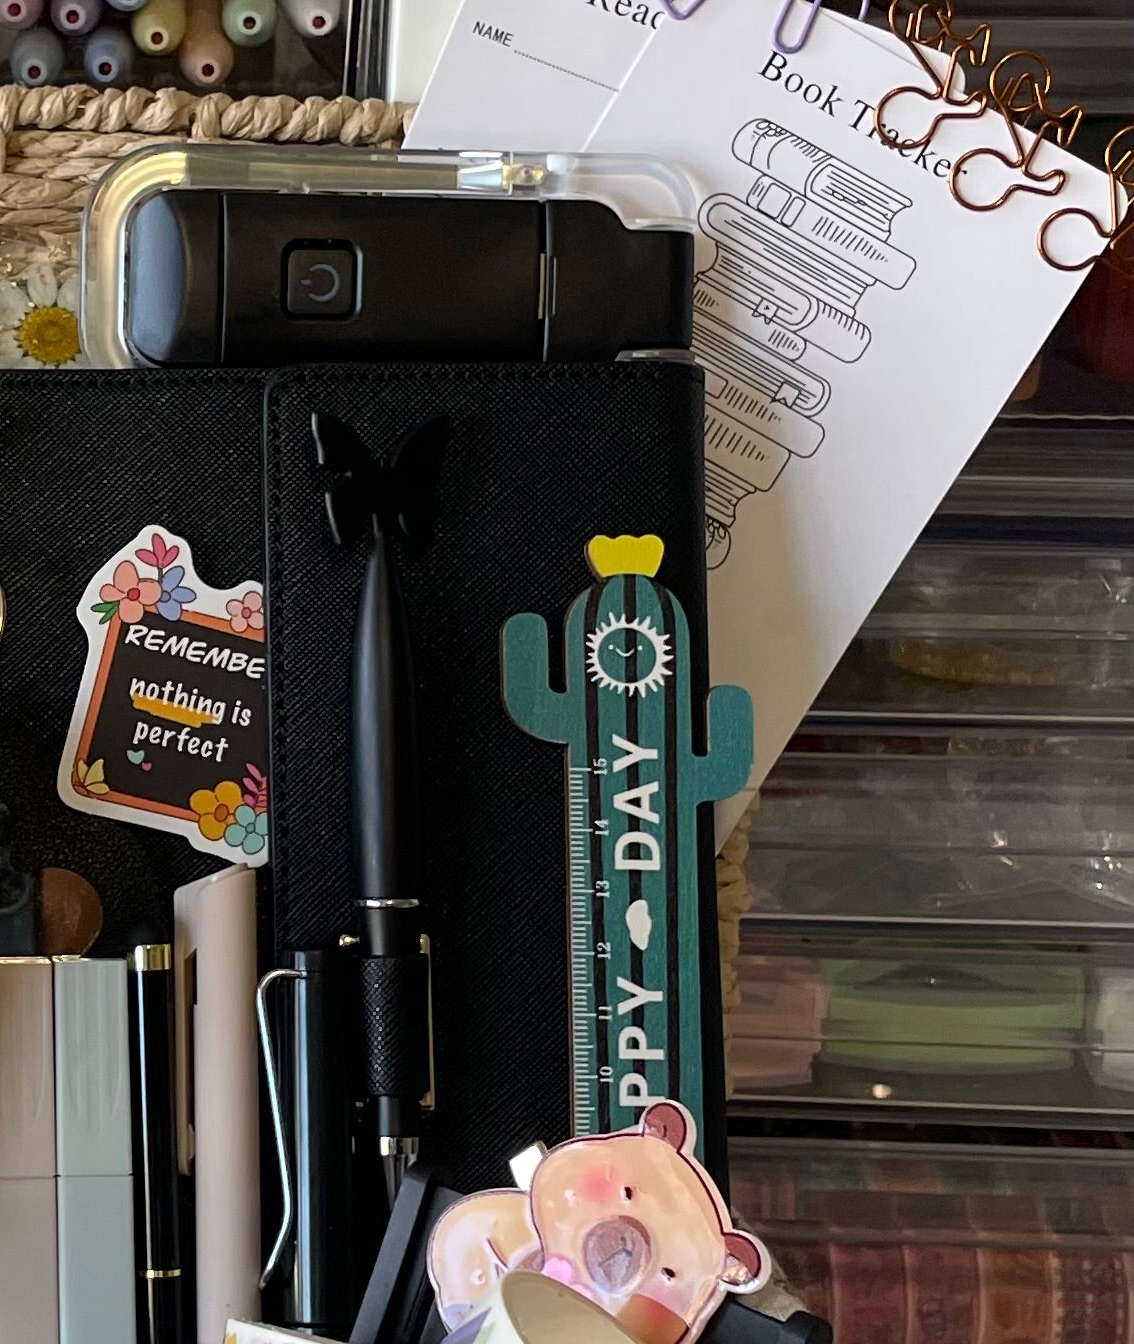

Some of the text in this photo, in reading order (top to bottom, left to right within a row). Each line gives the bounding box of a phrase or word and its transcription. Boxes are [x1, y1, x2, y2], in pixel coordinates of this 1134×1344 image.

[472, 20, 515, 48] NAME
[757, 49, 843, 118] Book
[129, 677, 252, 726] nothing is
[132, 721, 229, 763] perfect
[592, 757, 608, 775] 15
[611, 733, 661, 871] DAY
[594, 818, 609, 836] 14
[595, 879, 610, 898] 13
[596, 941, 611, 960] 12
[598, 1006, 613, 1021] 11
[599, 1066, 614, 1084] 10
